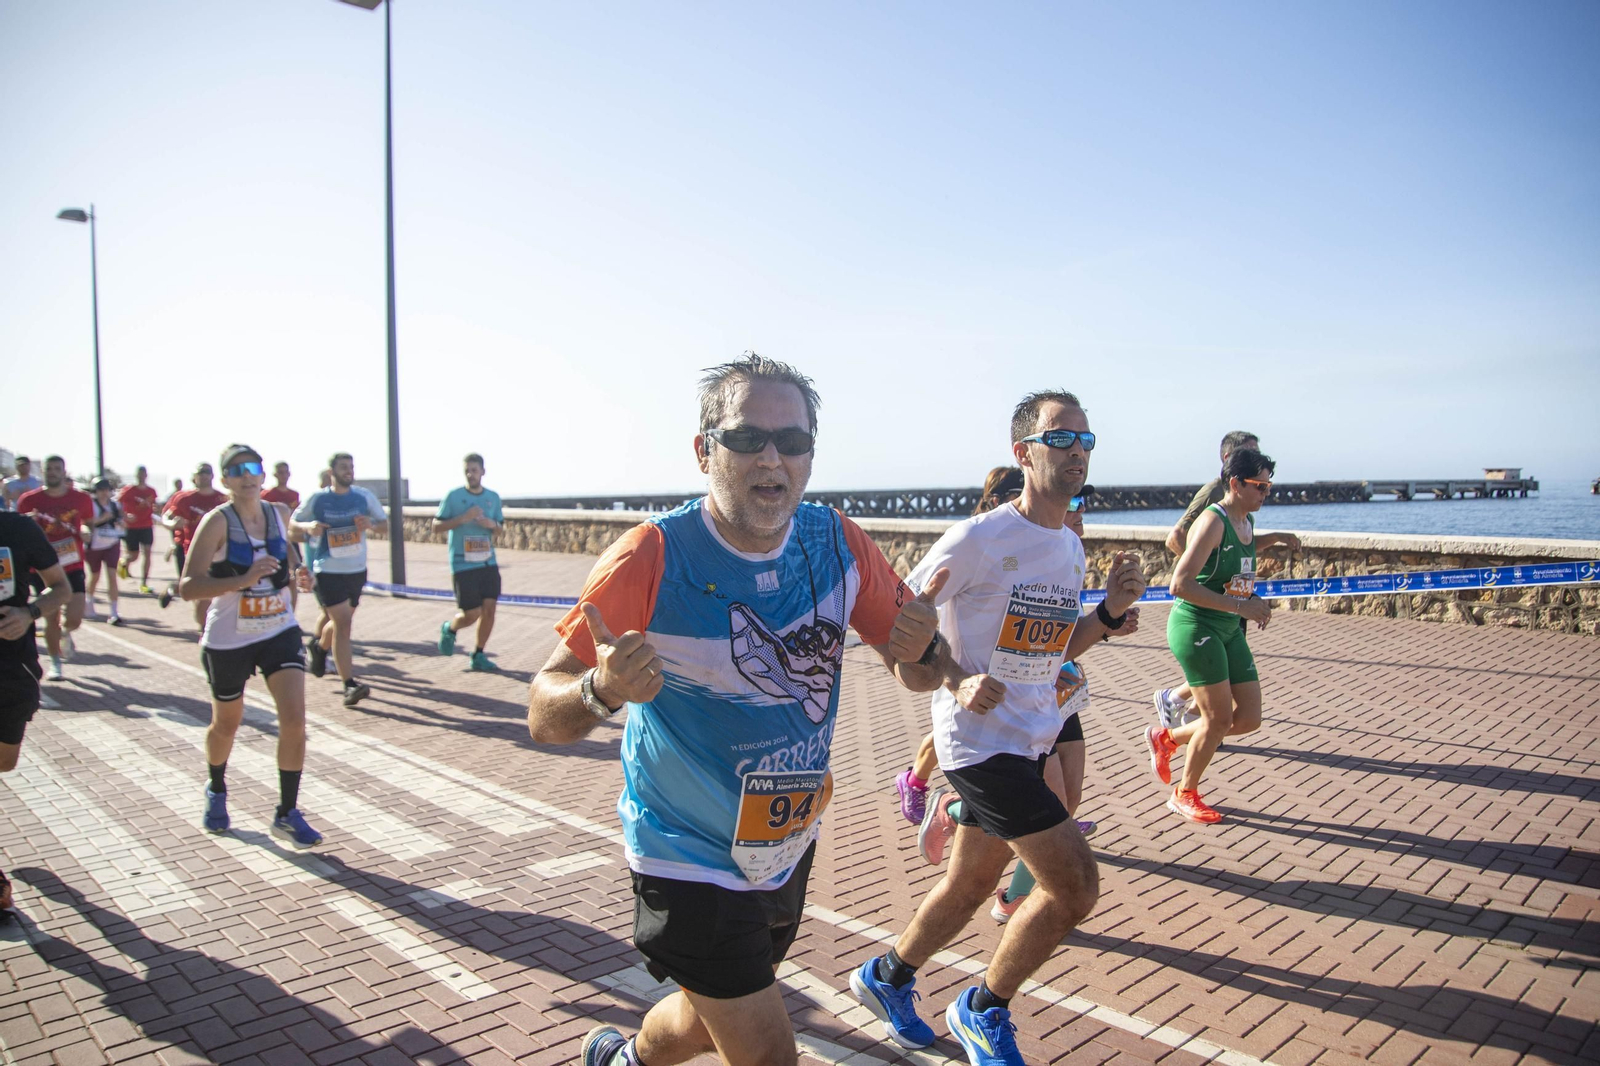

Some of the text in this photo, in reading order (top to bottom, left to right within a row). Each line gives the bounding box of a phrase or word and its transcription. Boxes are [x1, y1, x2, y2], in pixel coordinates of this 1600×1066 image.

[1002, 556, 1018, 568] 25
[1013, 583, 1047, 593] Medio
[1012, 618, 1070, 644] 1097
[738, 740, 772, 751] EDICIÓN
